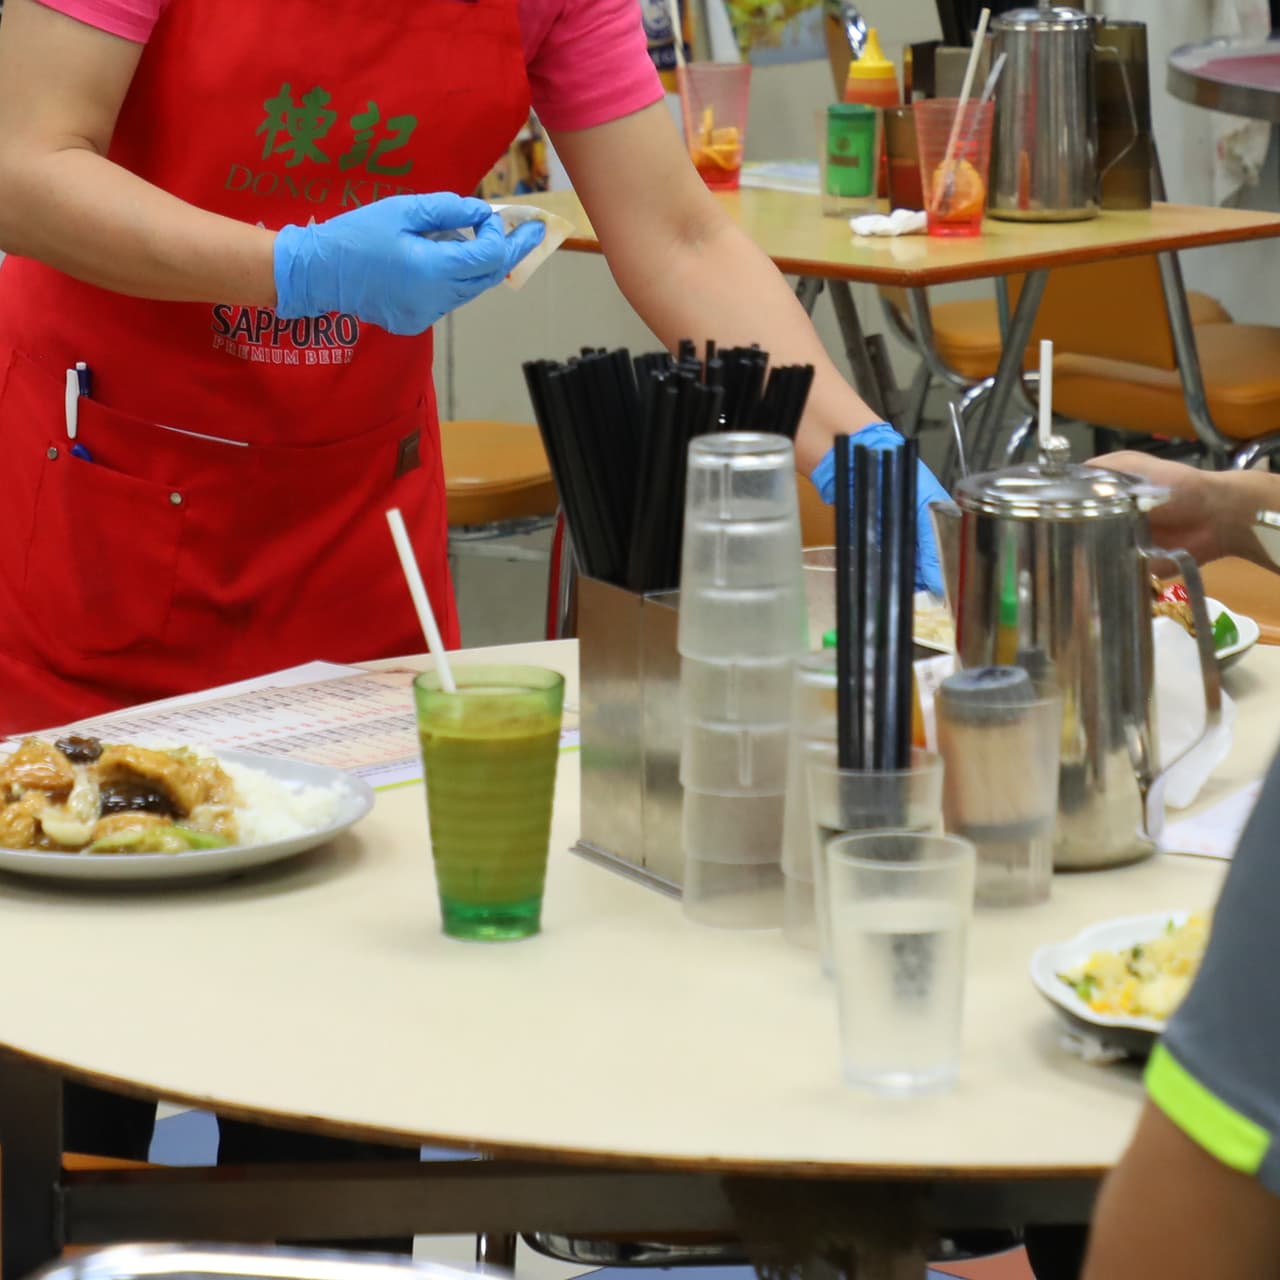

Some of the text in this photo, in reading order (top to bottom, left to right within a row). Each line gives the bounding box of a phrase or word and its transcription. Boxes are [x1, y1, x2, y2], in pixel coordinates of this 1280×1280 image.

[256, 82, 418, 176] 棟記
[225, 163, 331, 203] DONG
[212, 304, 359, 348] SAPPORO
